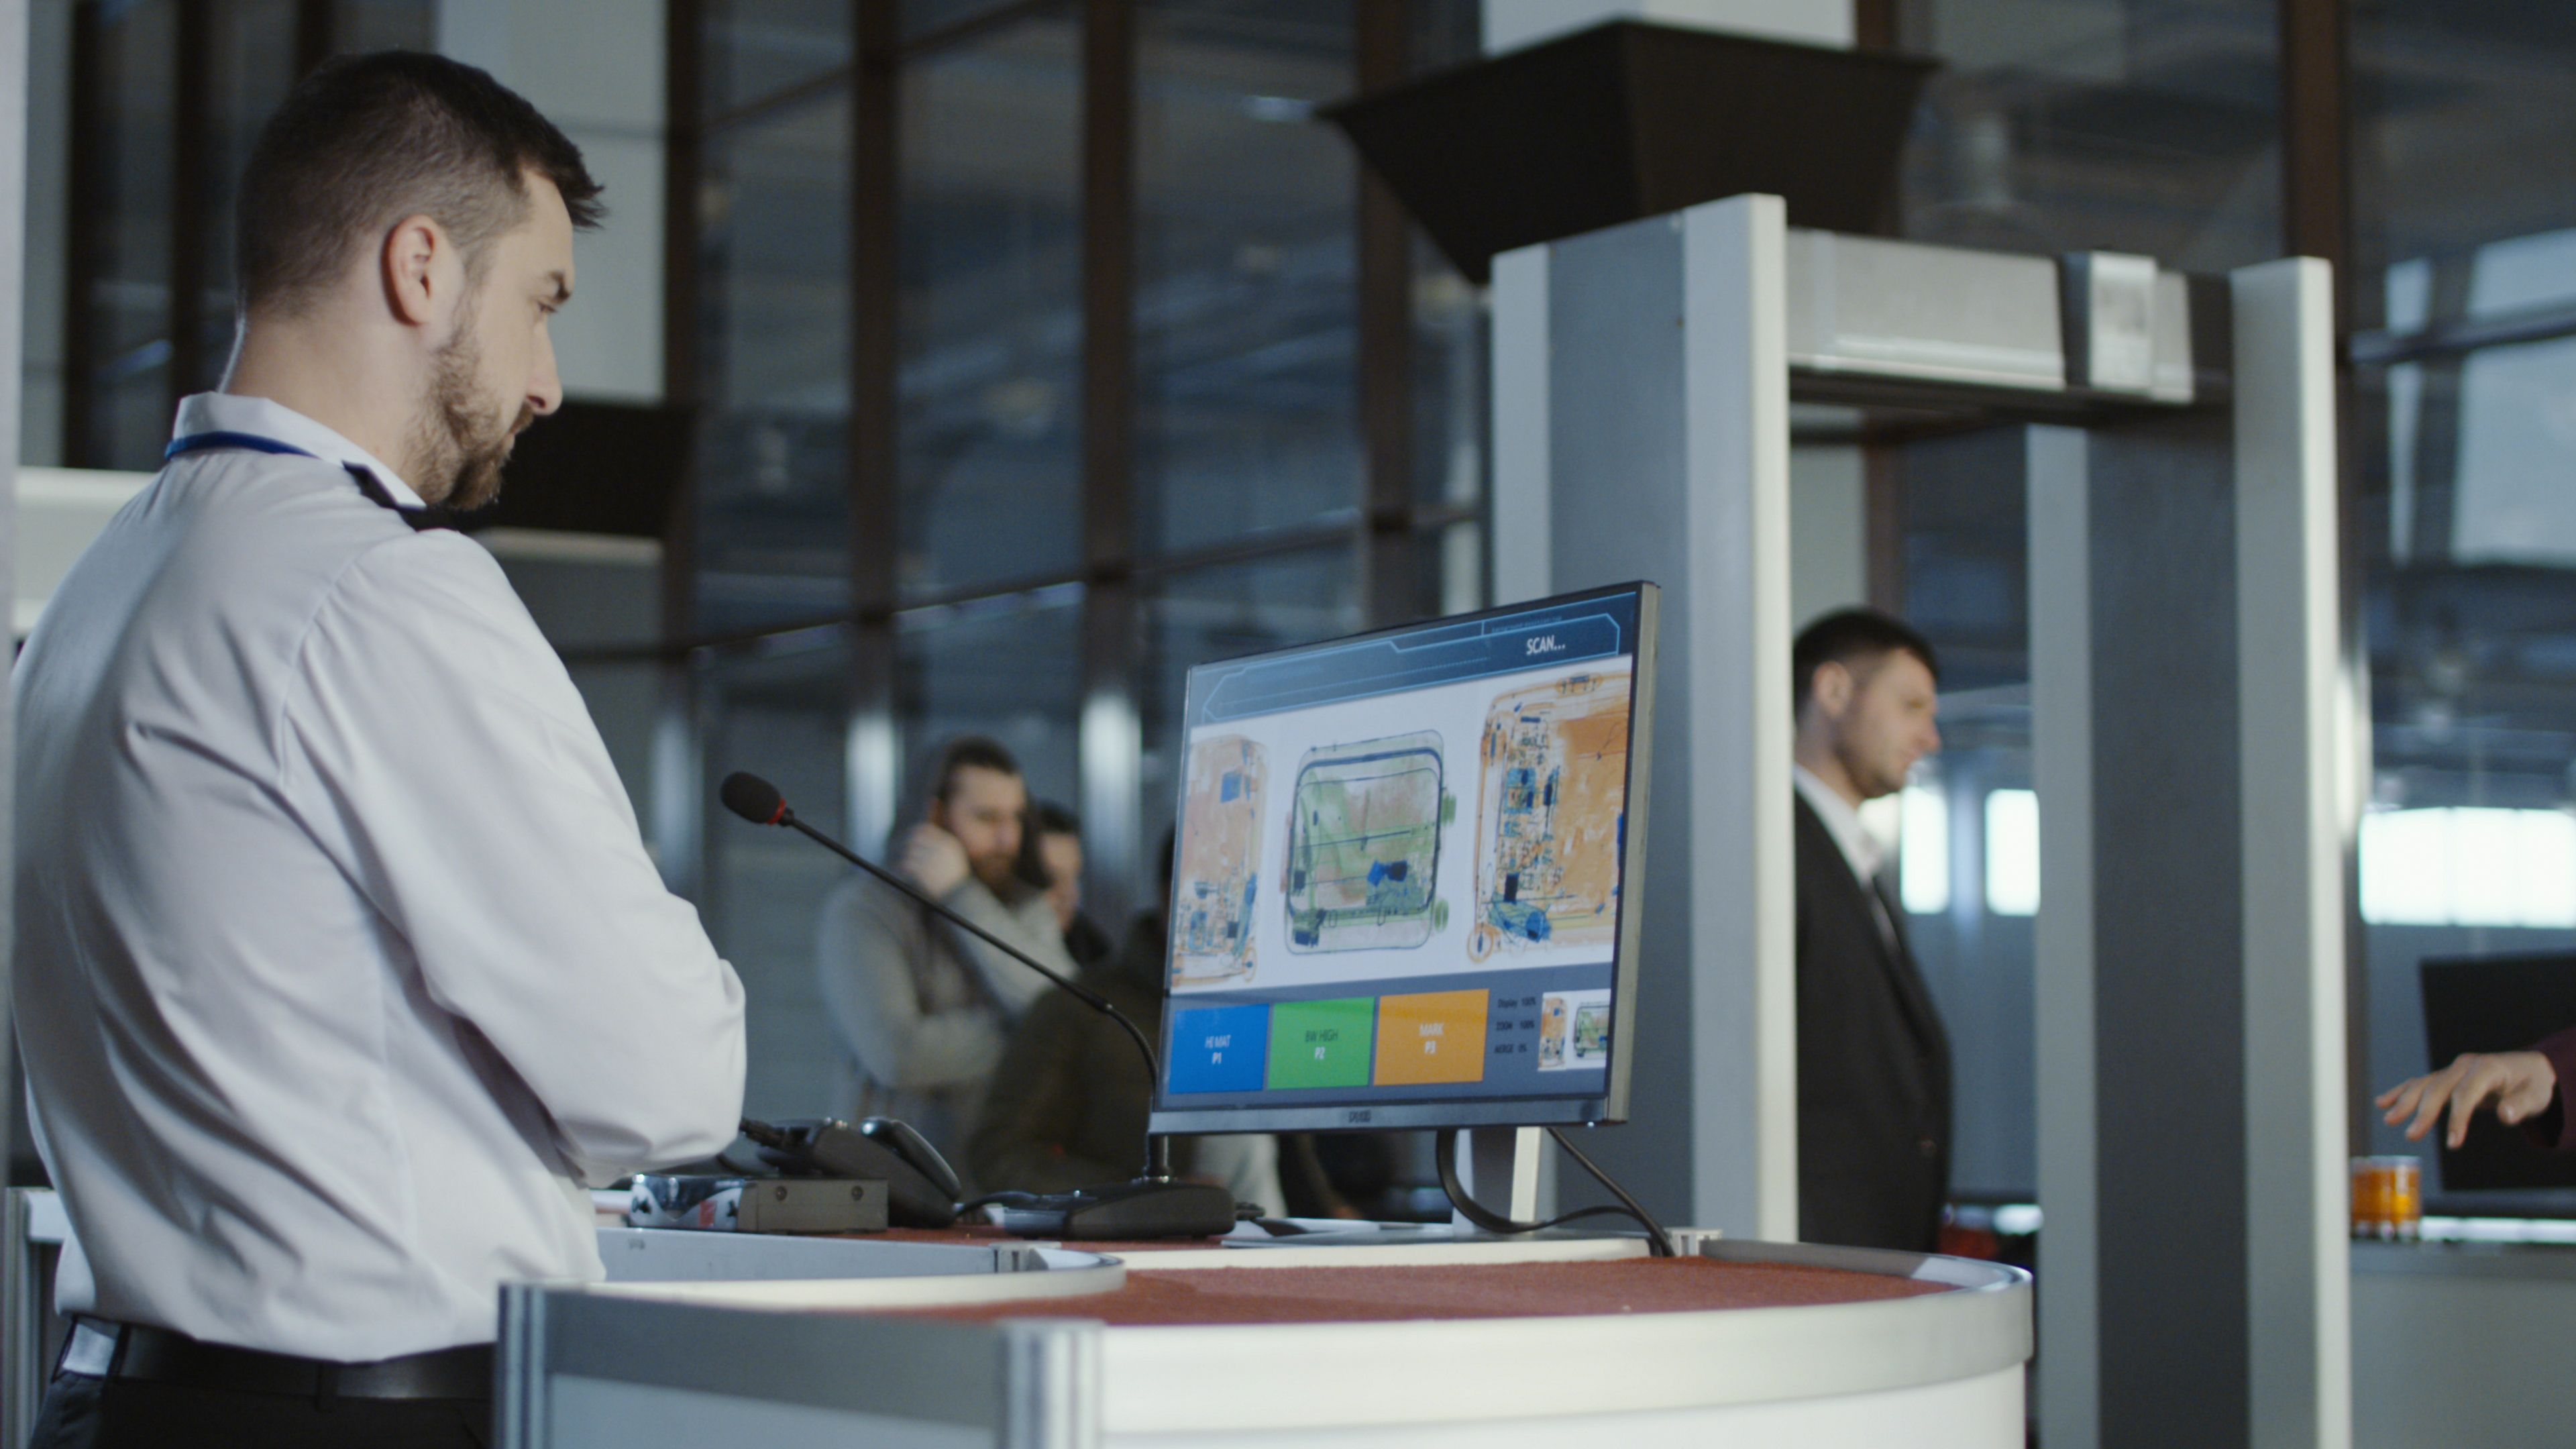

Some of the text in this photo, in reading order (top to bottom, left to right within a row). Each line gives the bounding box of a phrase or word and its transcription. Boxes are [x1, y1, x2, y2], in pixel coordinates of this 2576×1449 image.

[1526, 635, 1566, 655] SCAN...
[1319, 1029, 1339, 1042] HIGH
[1212, 1052, 1222, 1065] P1
[1314, 1046, 1326, 1060] P2
